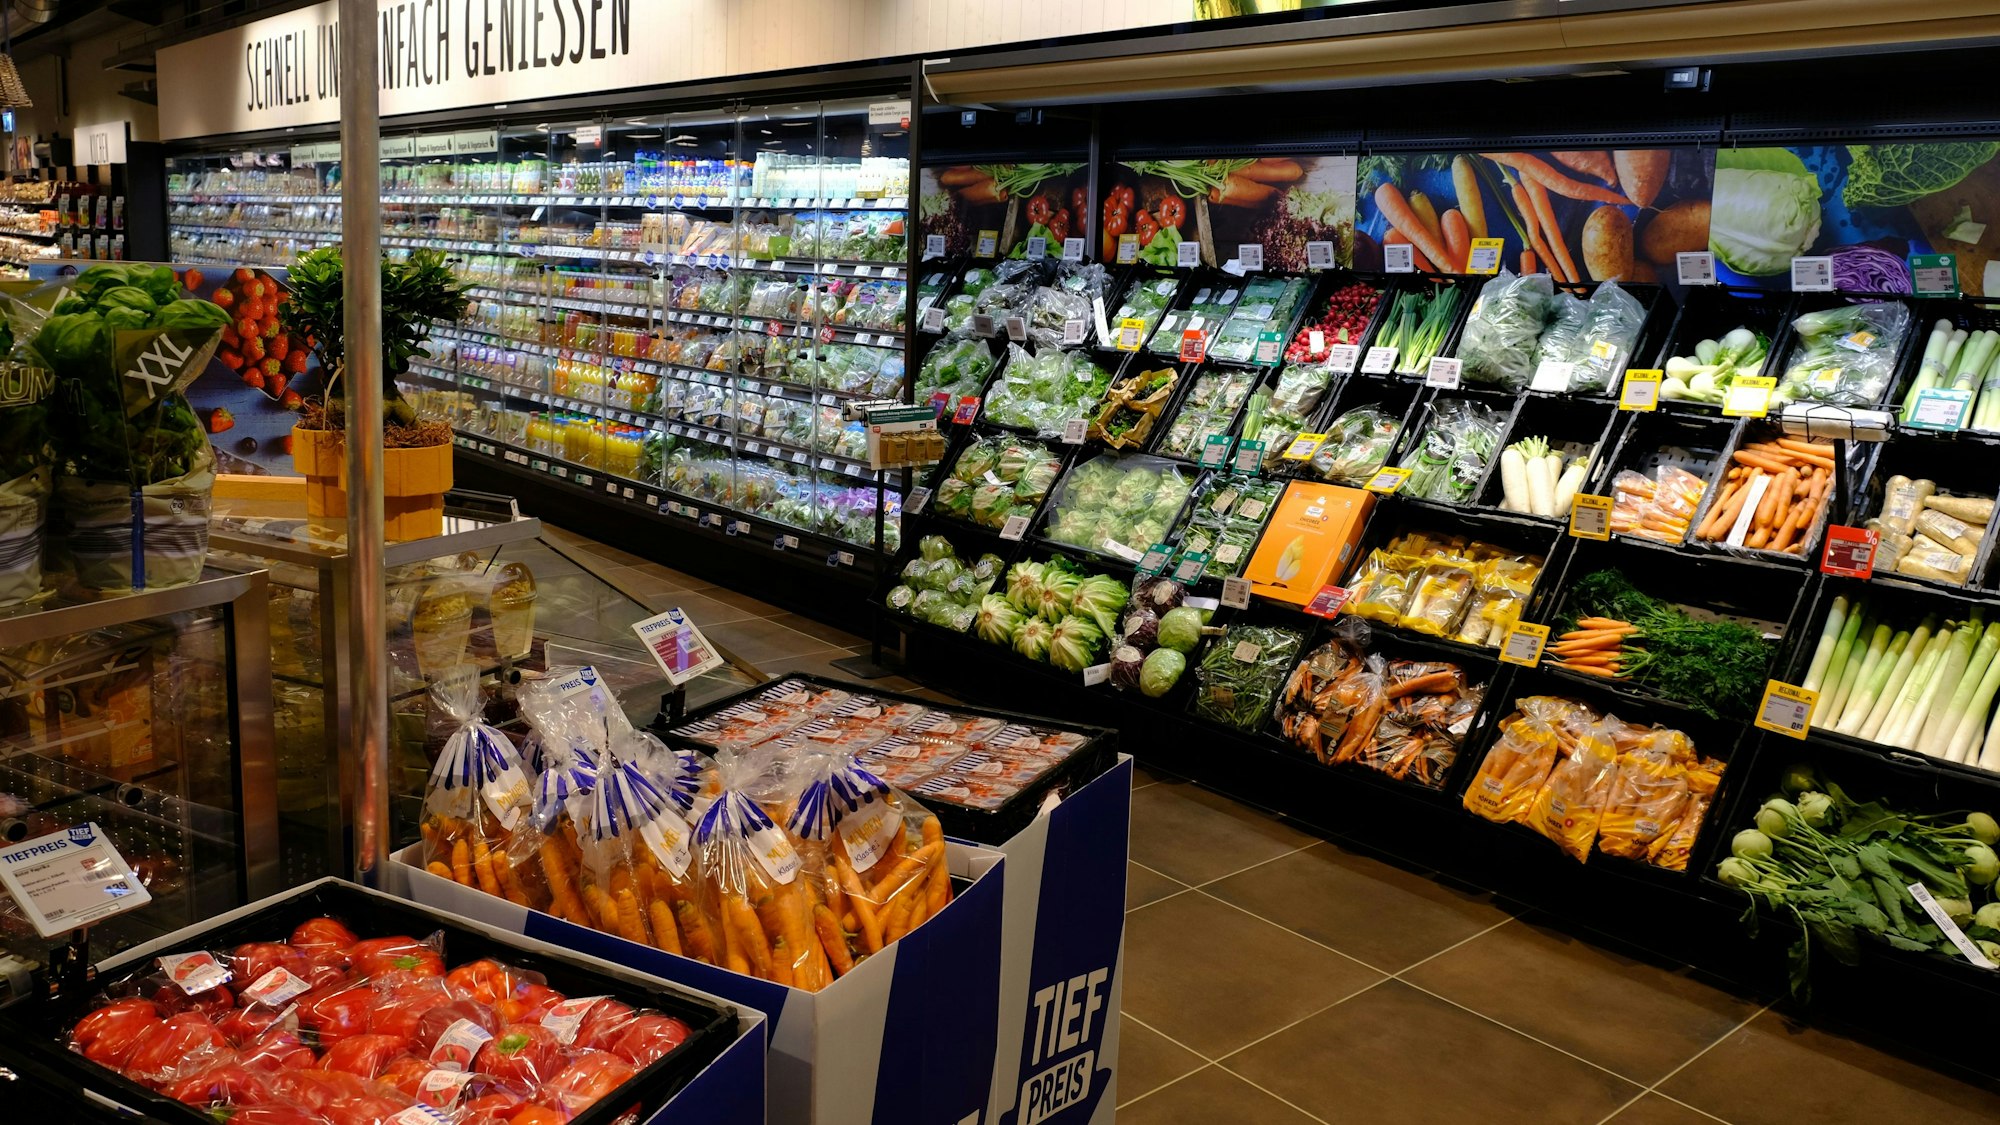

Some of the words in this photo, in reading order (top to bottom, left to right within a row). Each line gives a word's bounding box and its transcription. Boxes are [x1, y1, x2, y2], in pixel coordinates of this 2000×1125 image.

[246, 29, 310, 112] SCHNELL
[316, 20, 339, 101] UN
[378, 0, 450, 90] NFACH
[464, 0, 631, 78] GENIESSEN
[124, 333, 193, 399] XXL
[0, 367, 54, 402] UM
[640, 618, 672, 634] TIEFPREIS
[1779, 685, 1801, 698] REGIONAL
[69, 827, 91, 836] TIEF
[2, 839, 68, 864] TIEFPREIS
[1031, 966, 1109, 1067] TIEF
[1026, 1056, 1087, 1125] PREIS
